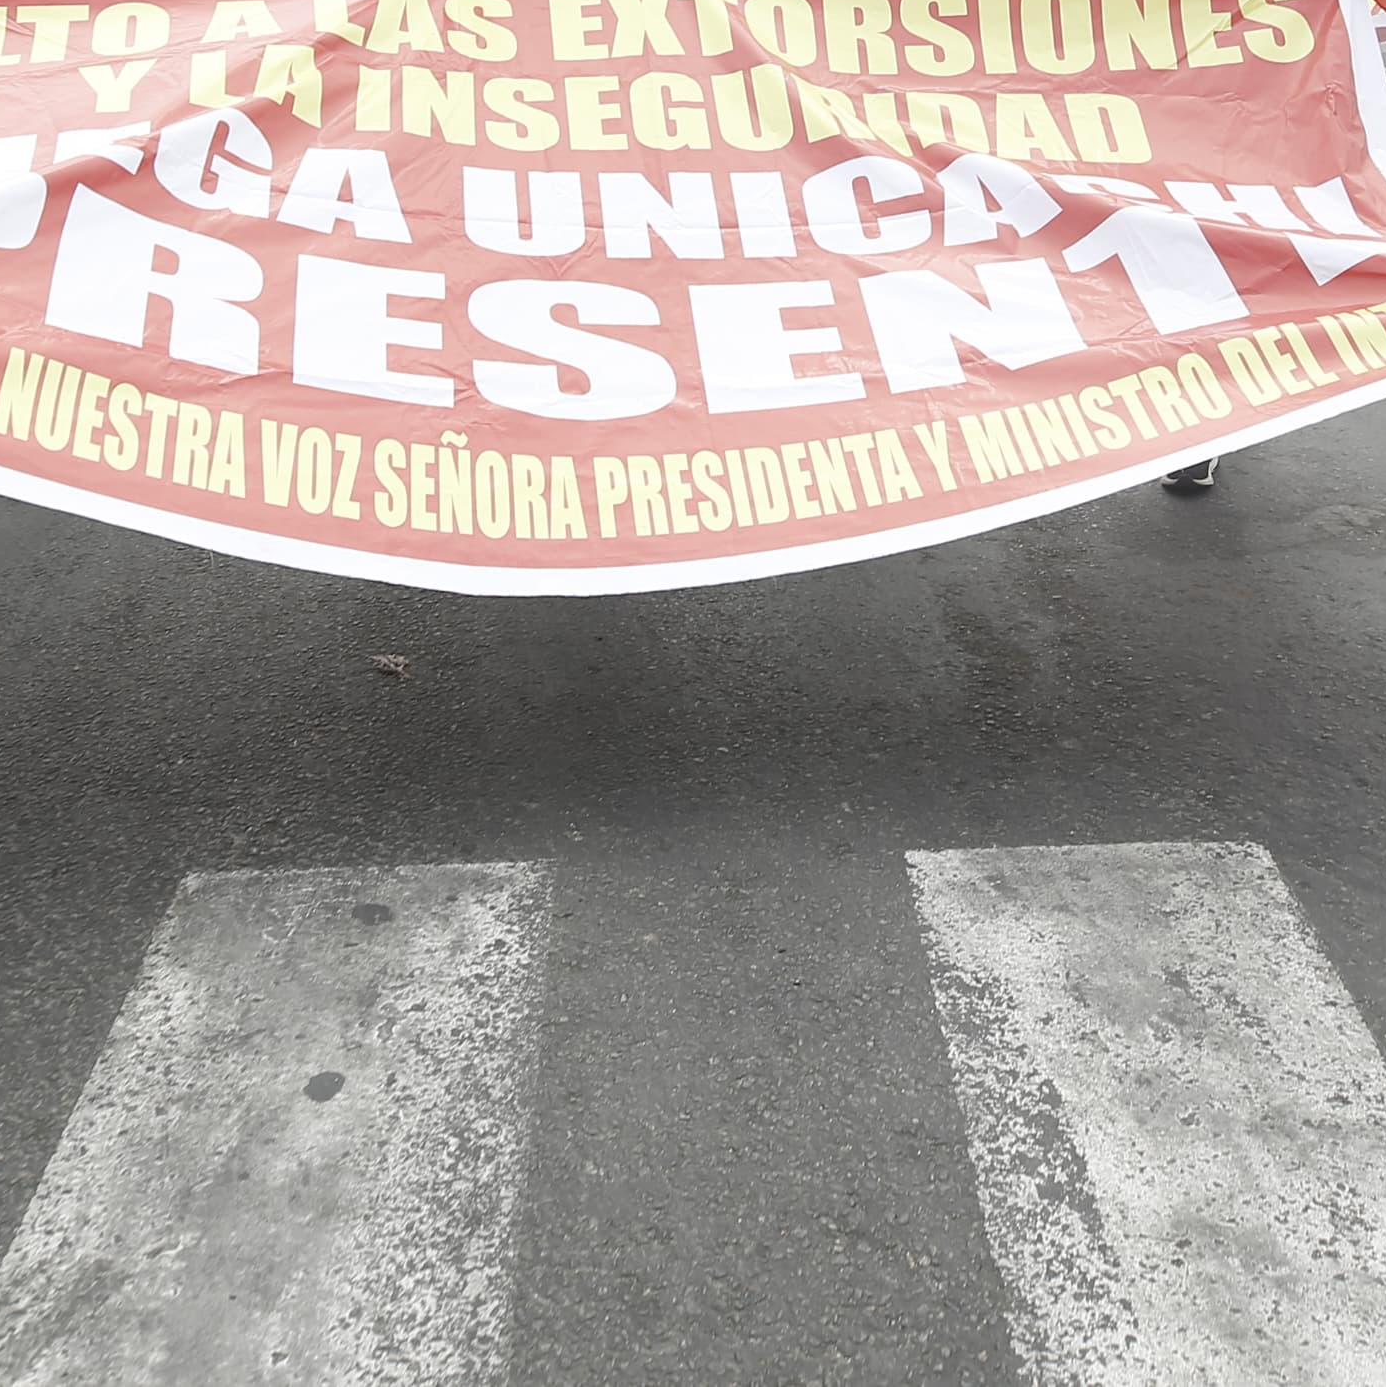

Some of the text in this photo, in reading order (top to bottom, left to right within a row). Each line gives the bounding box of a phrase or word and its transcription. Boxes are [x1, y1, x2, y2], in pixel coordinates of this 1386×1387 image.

[202, 0, 283, 43] A
[78, 45, 1153, 163] Y LA INSEGURIDAD
[260, 419, 362, 521] VOZ
[374, 429, 588, 541] SEÑORA
[593, 428, 924, 538] PRESIDENTA
[913, 420, 961, 494] Y
[958, 352, 1233, 486] MINISTRO
[1218, 324, 1342, 410] DEL
